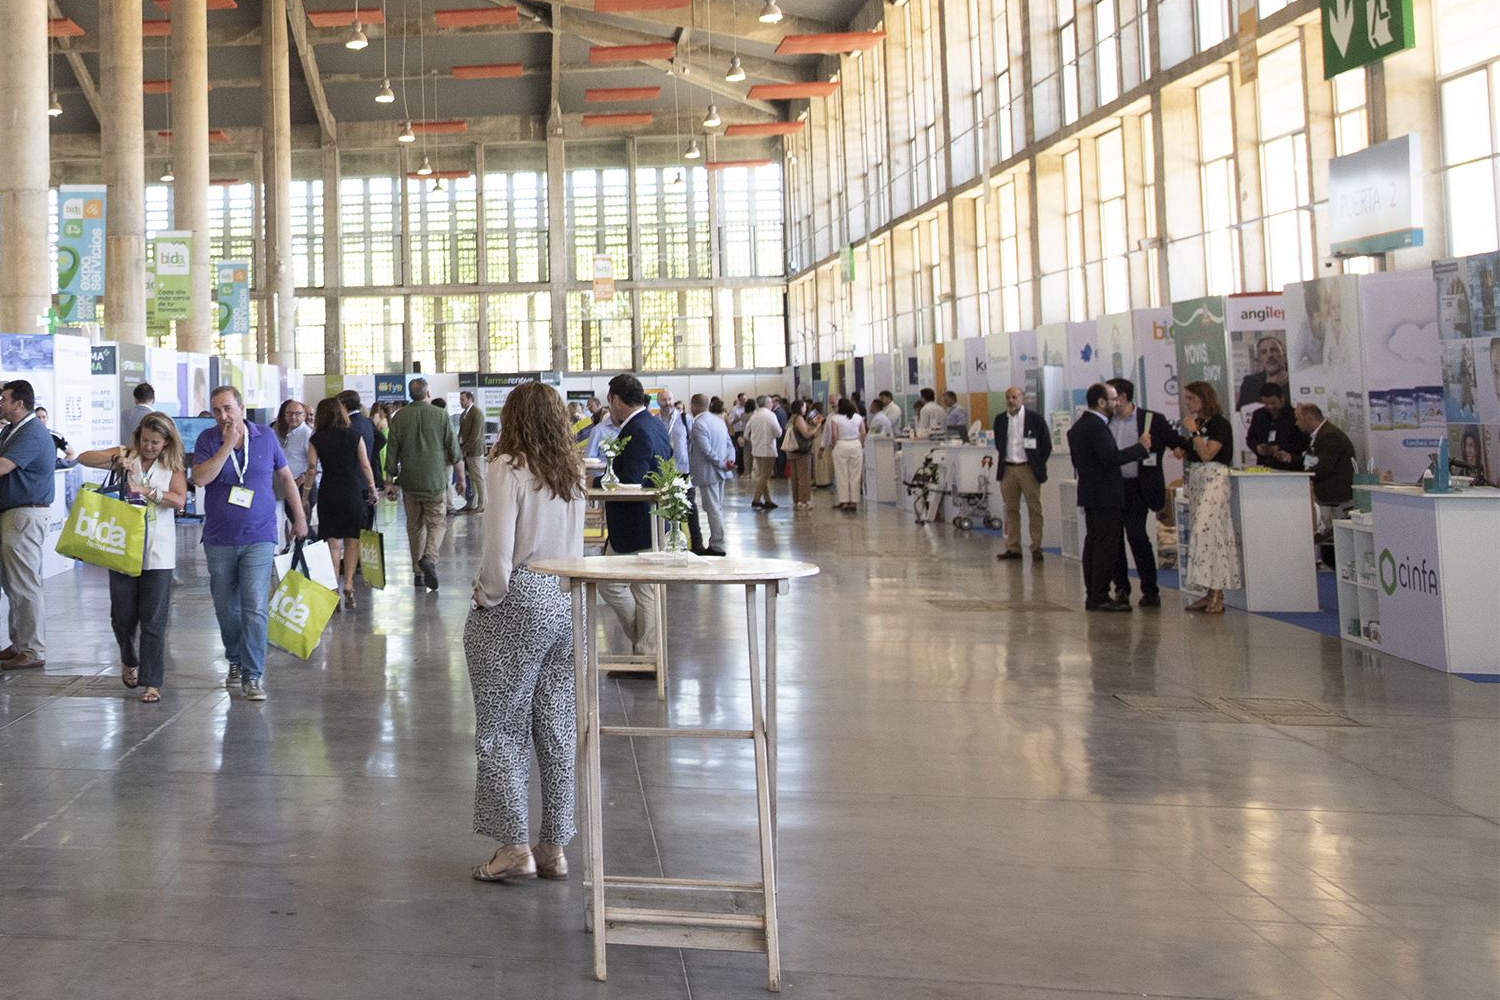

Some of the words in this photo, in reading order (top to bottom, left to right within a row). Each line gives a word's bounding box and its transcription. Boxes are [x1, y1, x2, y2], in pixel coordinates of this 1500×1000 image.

[1340, 187, 1381, 217] PUERTA
[1389, 181, 1397, 208] 2
[80, 255, 91, 291] expo
[88, 227, 102, 291] servicios
[161, 252, 185, 265] bida
[74, 507, 126, 549] bida
